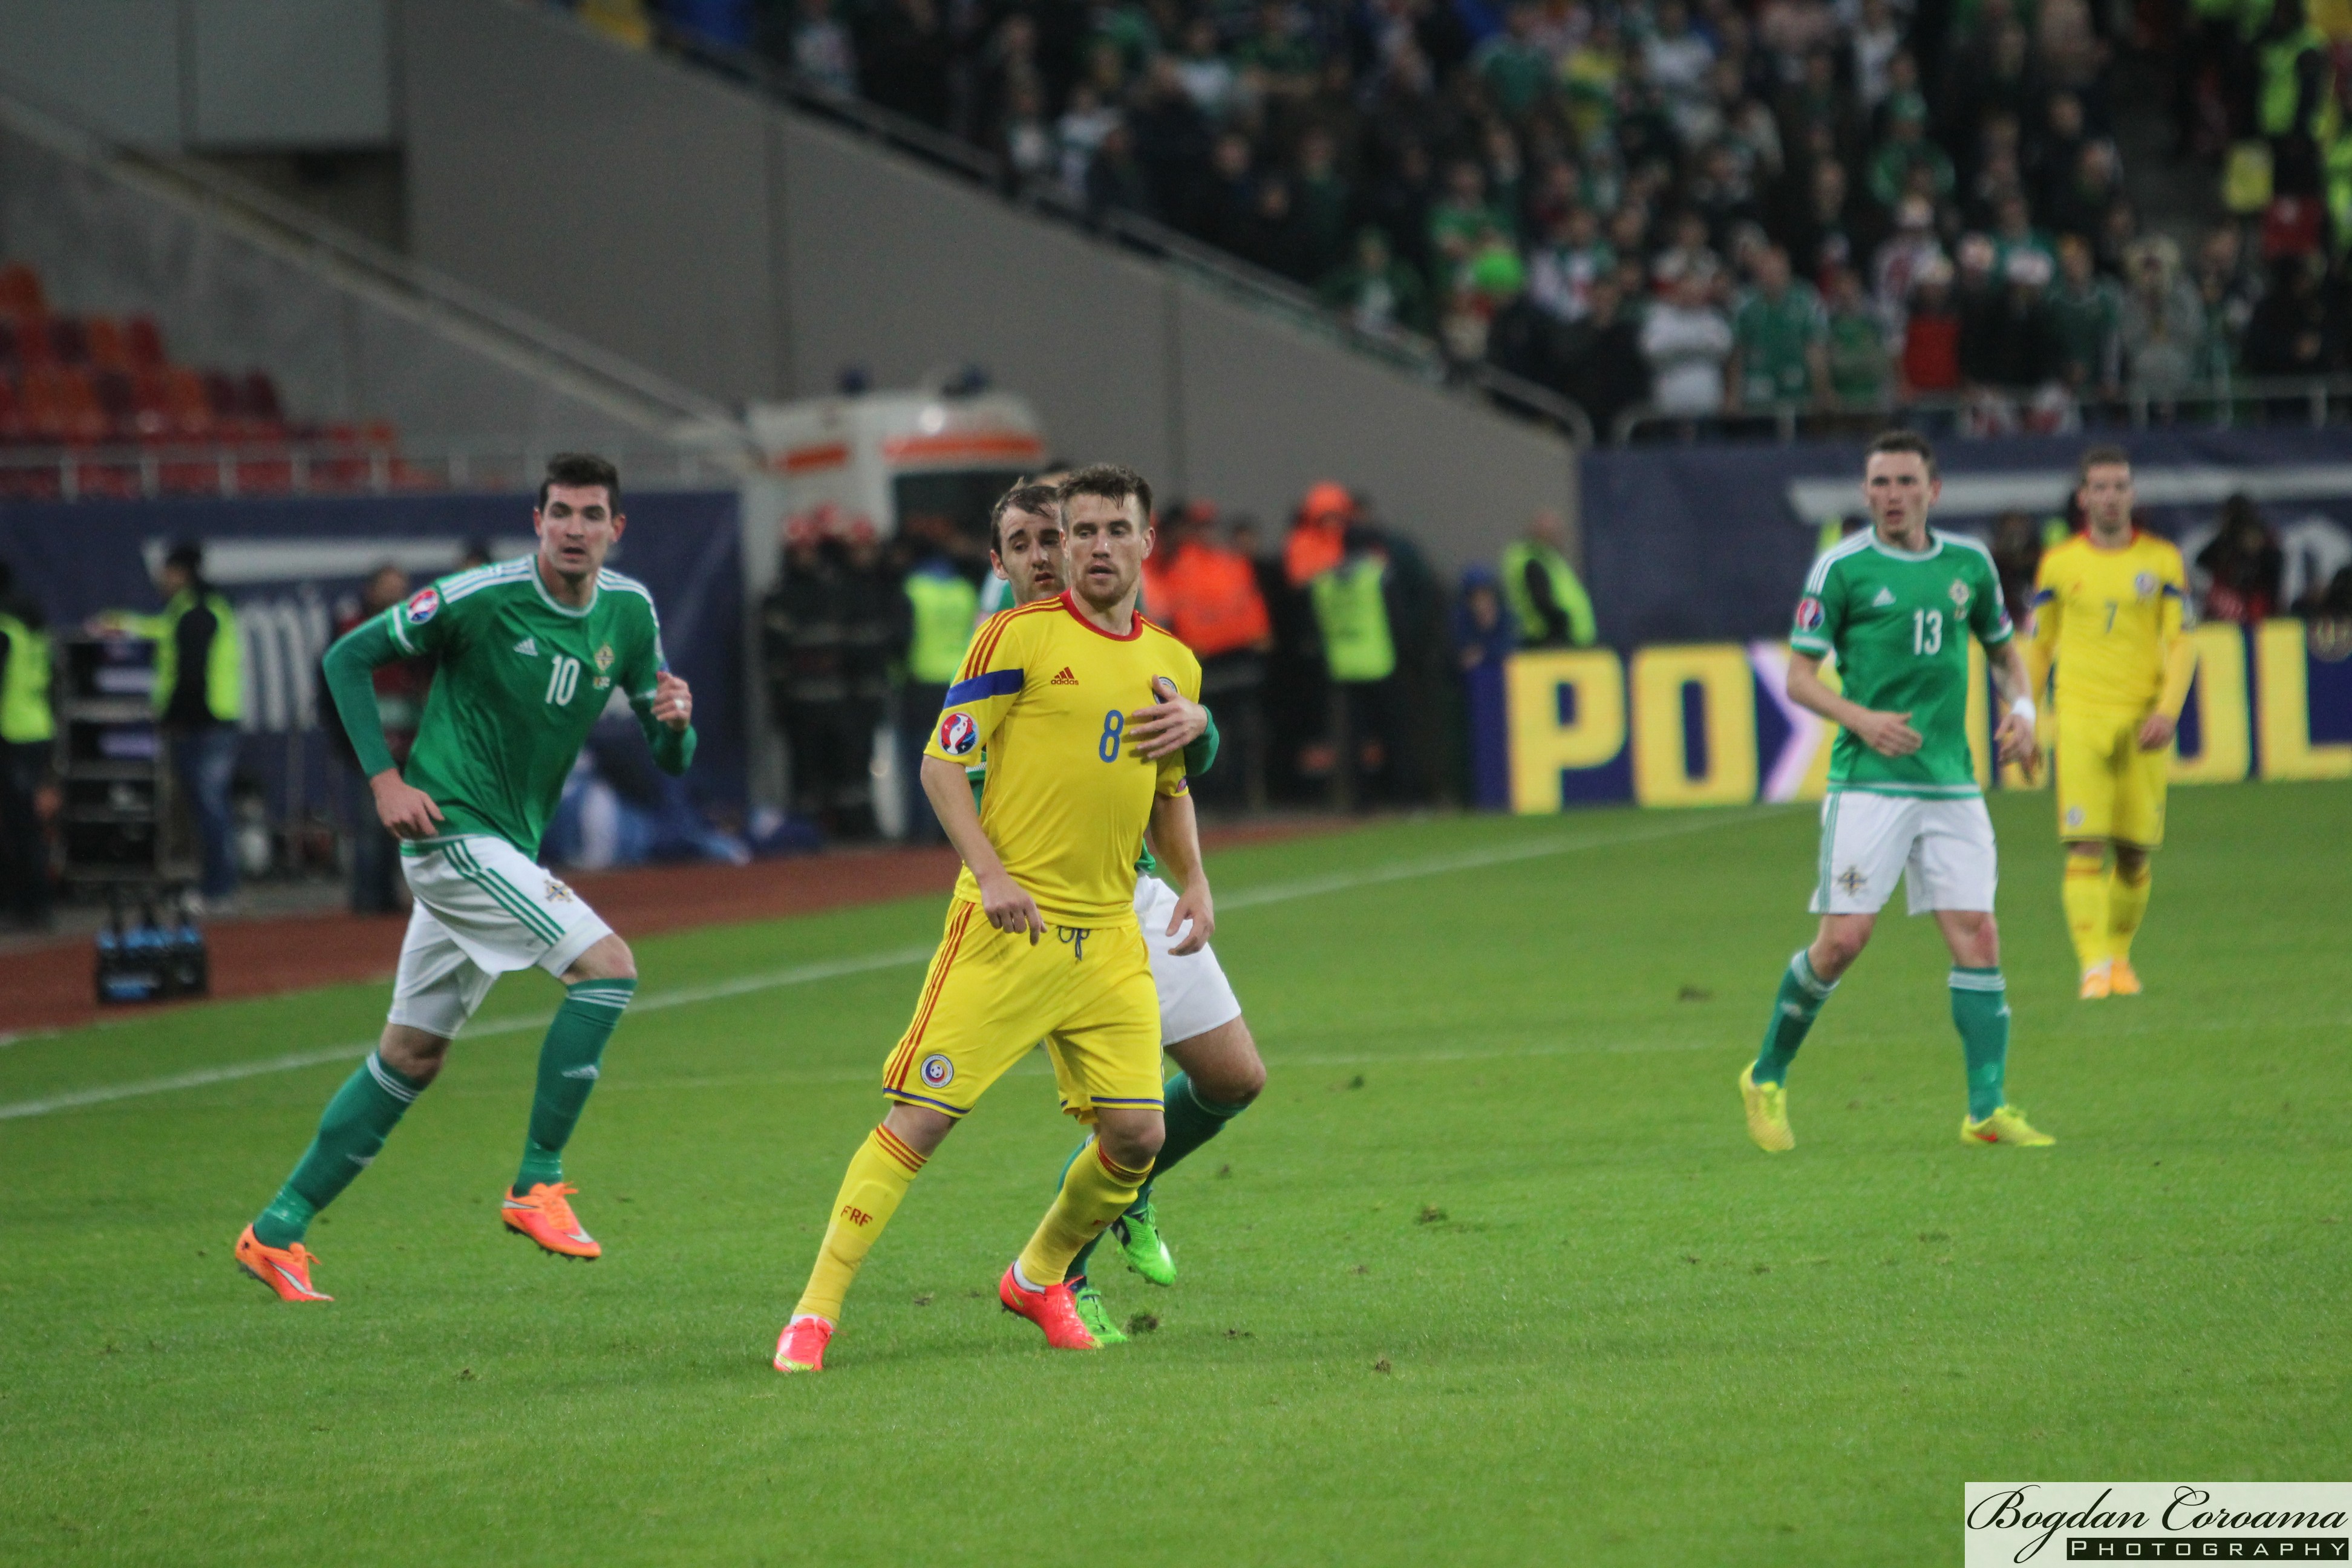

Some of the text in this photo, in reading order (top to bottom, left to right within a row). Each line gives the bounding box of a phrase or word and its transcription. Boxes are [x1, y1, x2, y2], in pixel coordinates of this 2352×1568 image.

[1913, 609, 1942, 655] 13
[2106, 603, 2118, 632] 7
[546, 655, 580, 706] 10
[1099, 710, 1124, 763] 8
[841, 1205, 873, 1227] FRF
